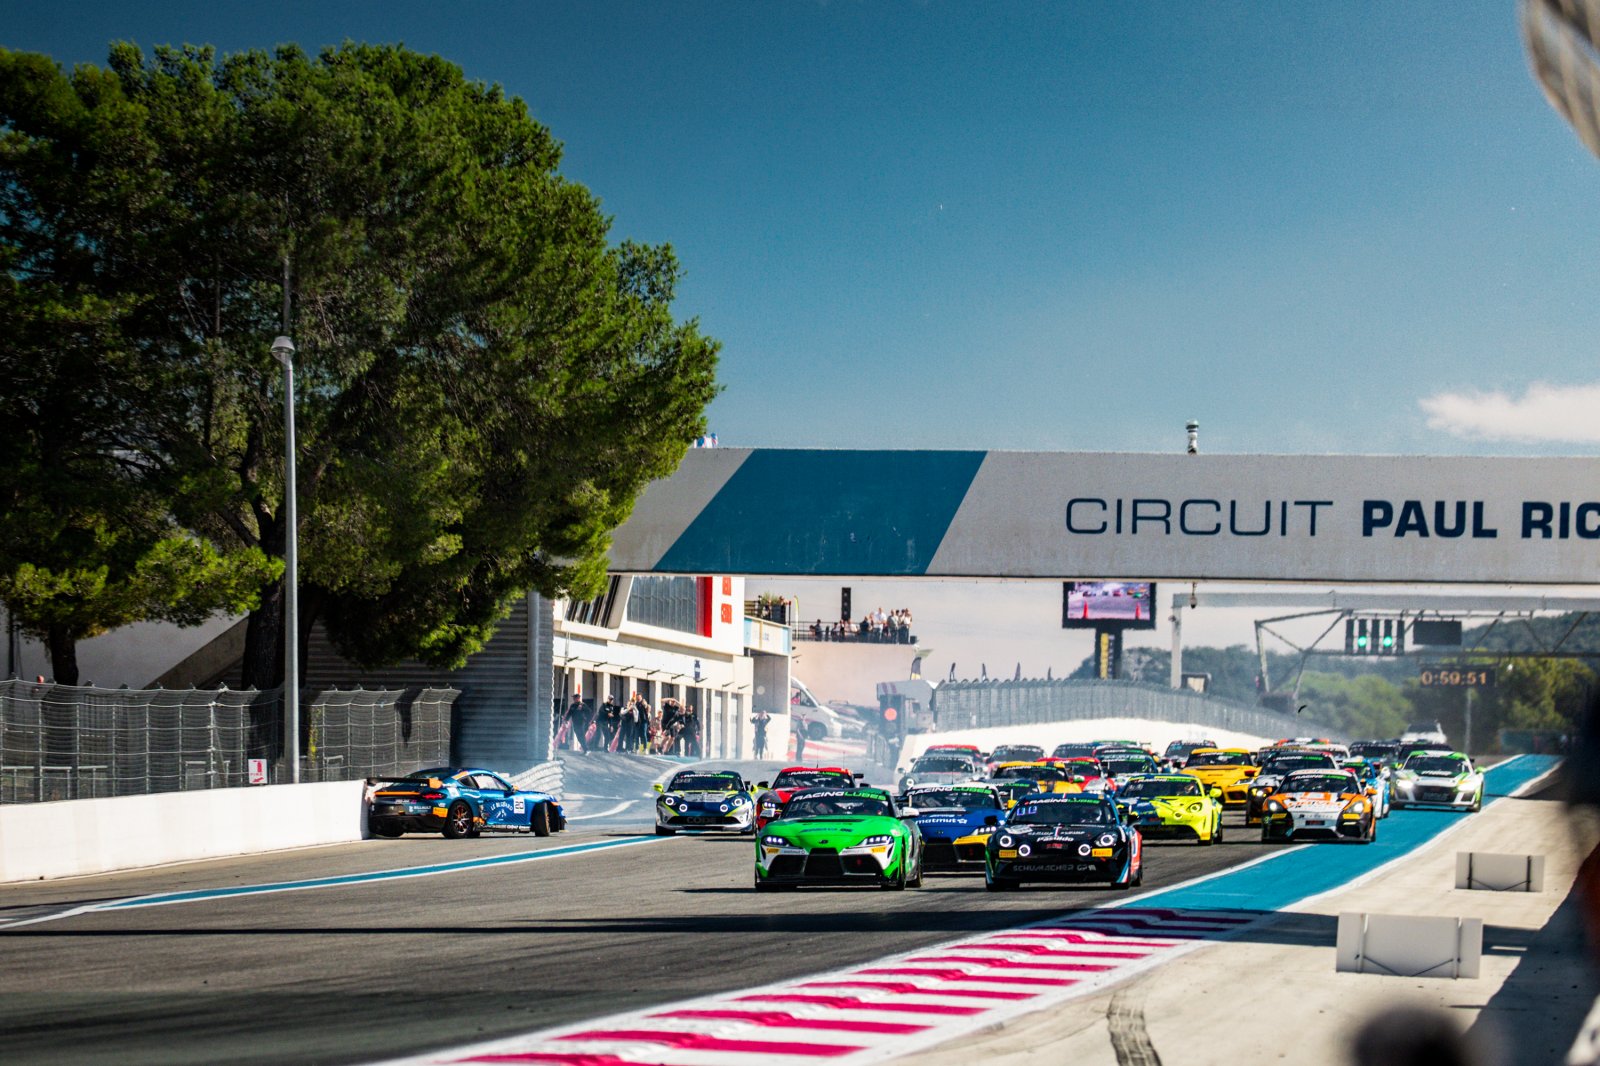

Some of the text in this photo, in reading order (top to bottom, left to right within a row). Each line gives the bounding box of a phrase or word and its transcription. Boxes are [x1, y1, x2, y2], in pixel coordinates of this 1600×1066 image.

[1066, 498, 1600, 539] CIRCUIT PAUL RIC
[1012, 864, 1074, 872] SCHUMACHER
